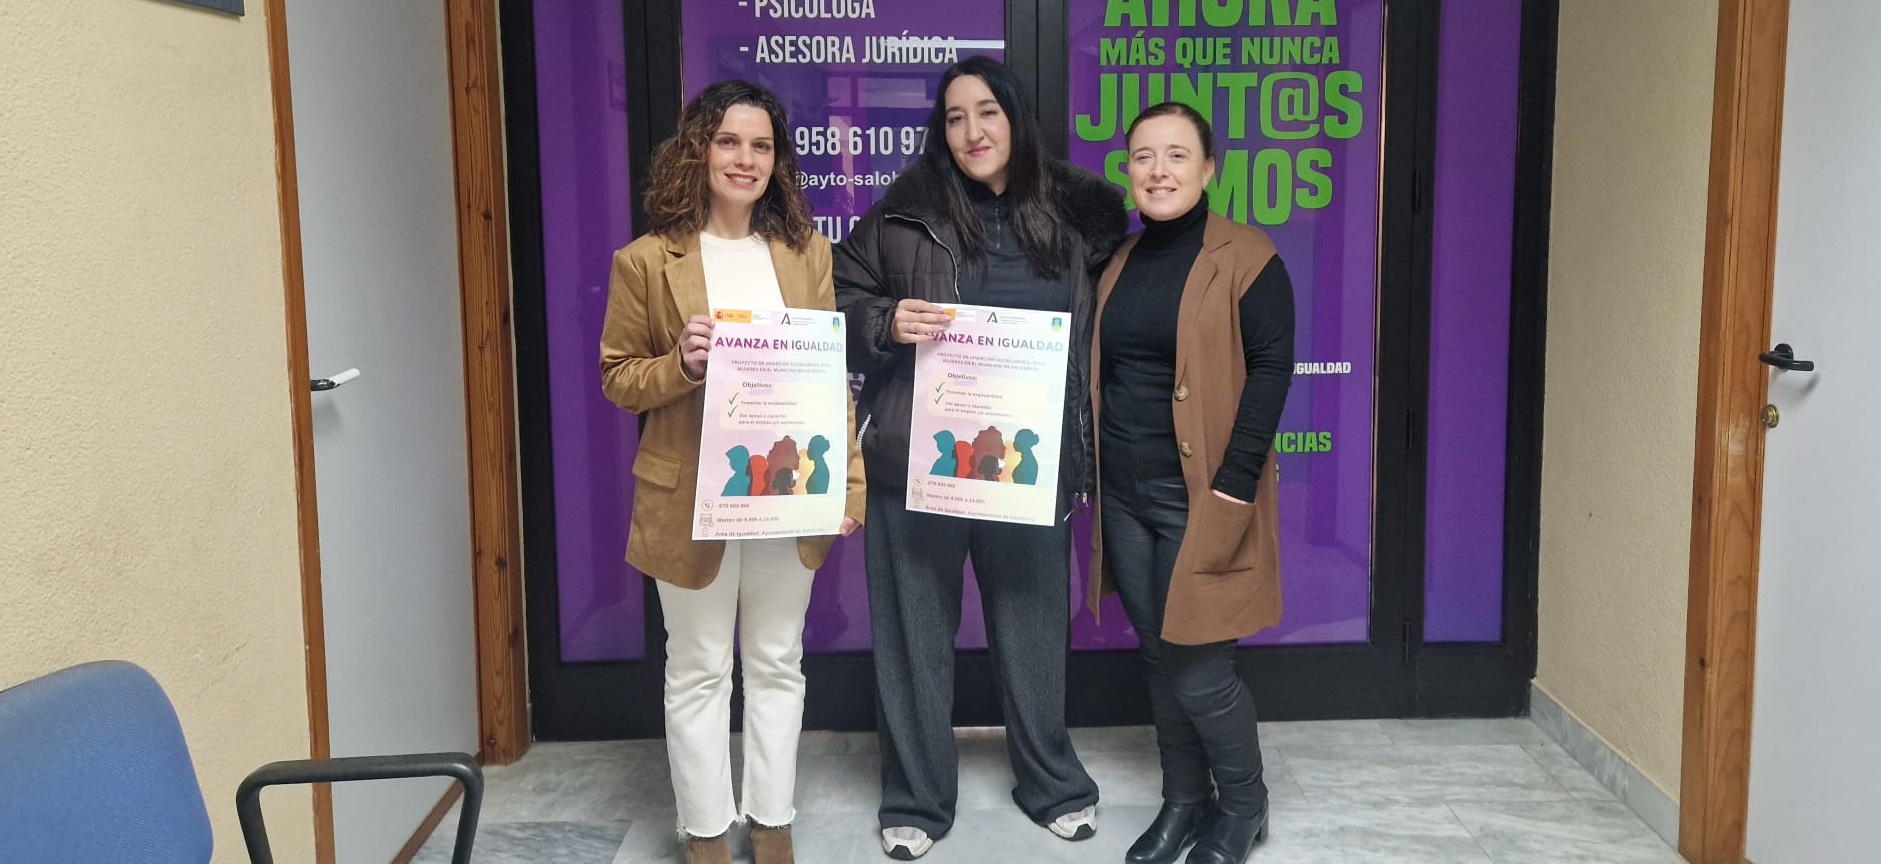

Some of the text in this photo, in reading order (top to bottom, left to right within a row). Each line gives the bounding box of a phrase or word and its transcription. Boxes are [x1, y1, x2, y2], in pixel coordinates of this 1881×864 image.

[756, 35, 856, 63] ASESORA
[862, 30, 958, 64] JURÍDICA
[1100, 30, 1340, 68] MÁS QUE NUNCA
[1075, 70, 1363, 142] JUNT@S
[795, 126, 929, 155] 958 610 97
[1104, 148, 1332, 226] SMOS
[715, 336, 843, 352] AVANZA EN IGUALDAD
[926, 331, 1064, 352] VANZA EN IGUALDAD
